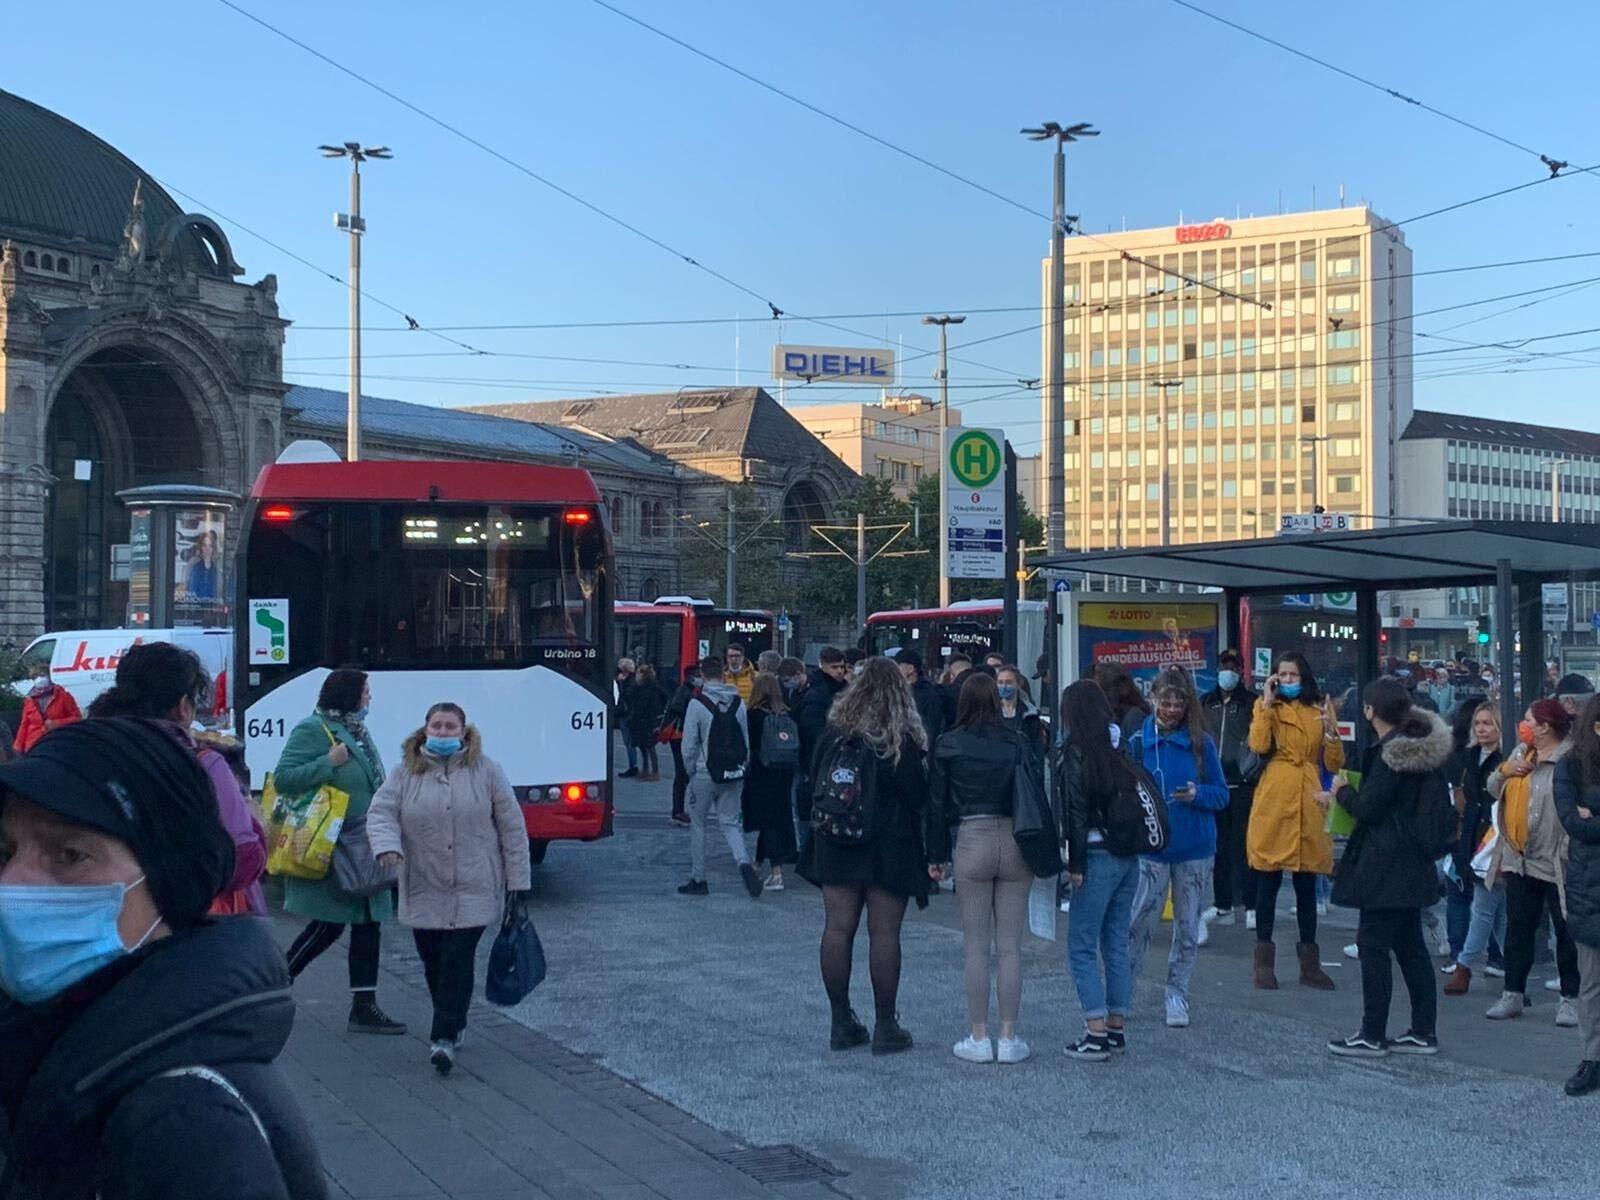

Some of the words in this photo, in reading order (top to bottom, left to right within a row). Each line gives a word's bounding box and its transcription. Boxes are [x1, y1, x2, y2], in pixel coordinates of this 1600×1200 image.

[785, 352, 886, 376] DIEHL
[963, 444, 988, 475] H
[1120, 610, 1153, 620] LOTTO
[544, 649, 581, 658] Urbino
[584, 648, 596, 658] 18
[248, 718, 285, 738] 641
[571, 711, 604, 730] 641
